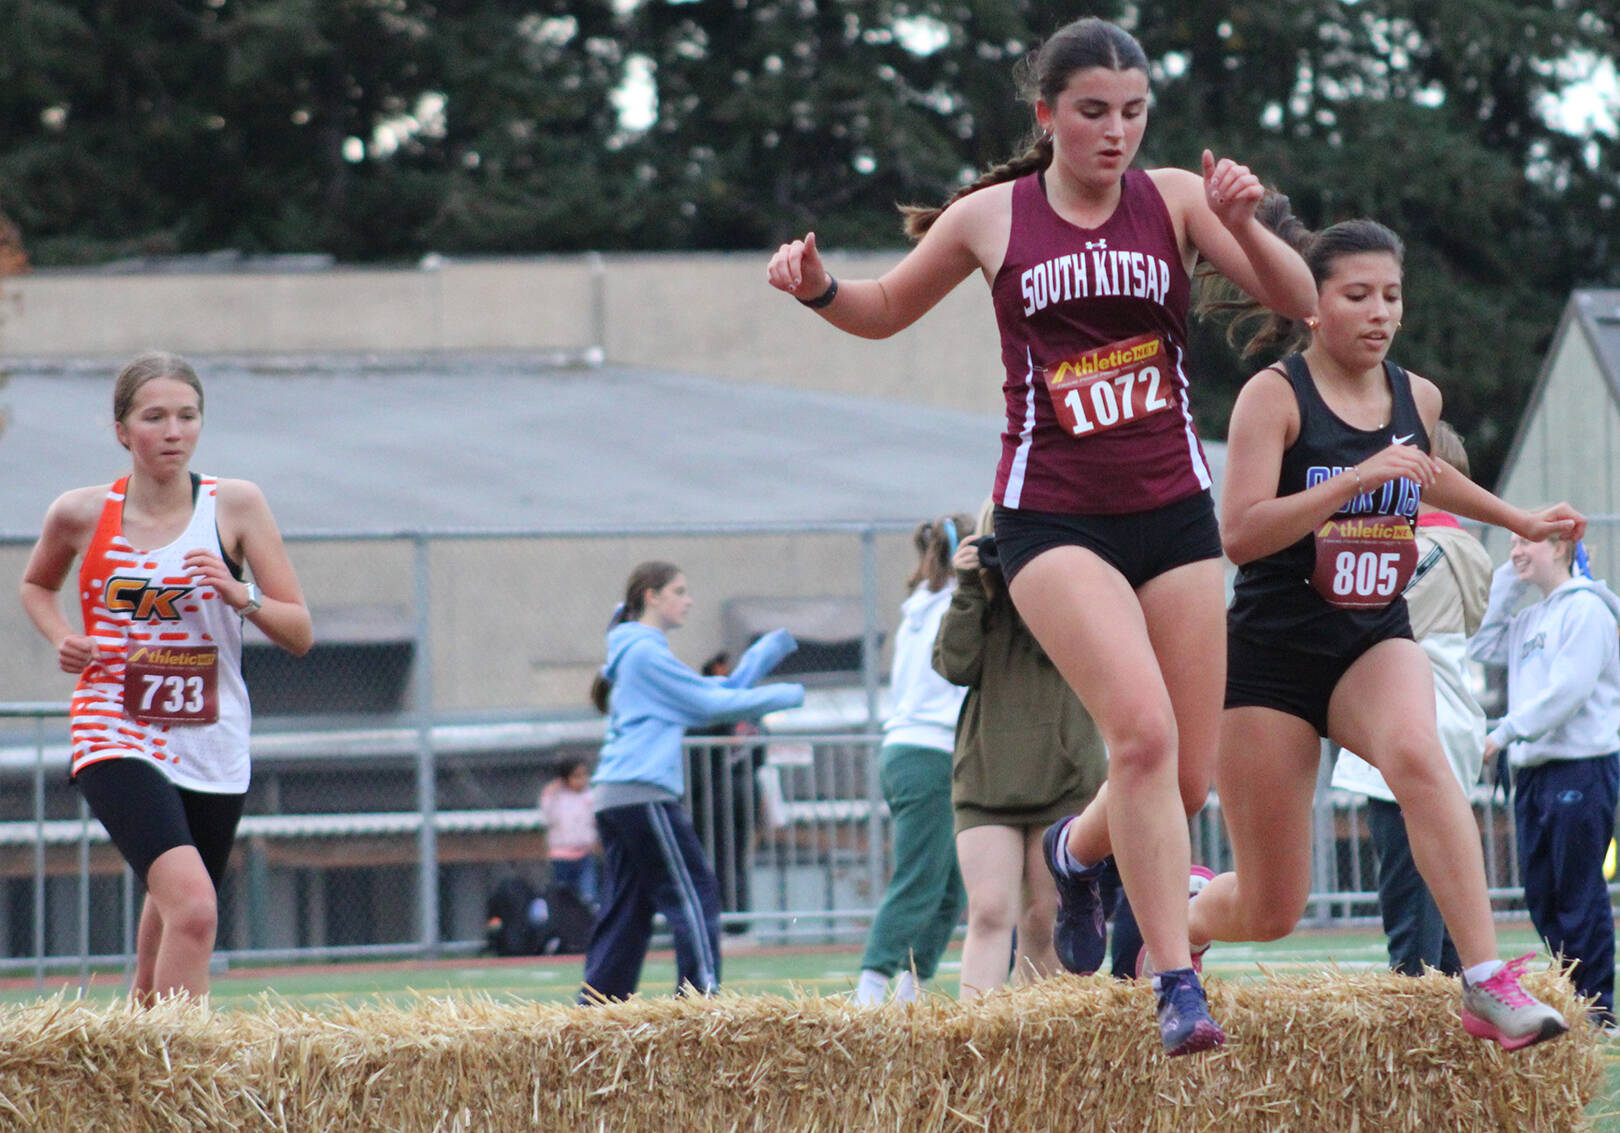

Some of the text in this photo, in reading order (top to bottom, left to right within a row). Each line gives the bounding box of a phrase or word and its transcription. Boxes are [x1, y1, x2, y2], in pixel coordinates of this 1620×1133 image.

[1021, 250, 1171, 317] SOUTH KITSAP
[1064, 366, 1167, 434] 1072
[1332, 551, 1400, 596] 805
[105, 576, 193, 620] CK
[141, 674, 205, 713] 733
